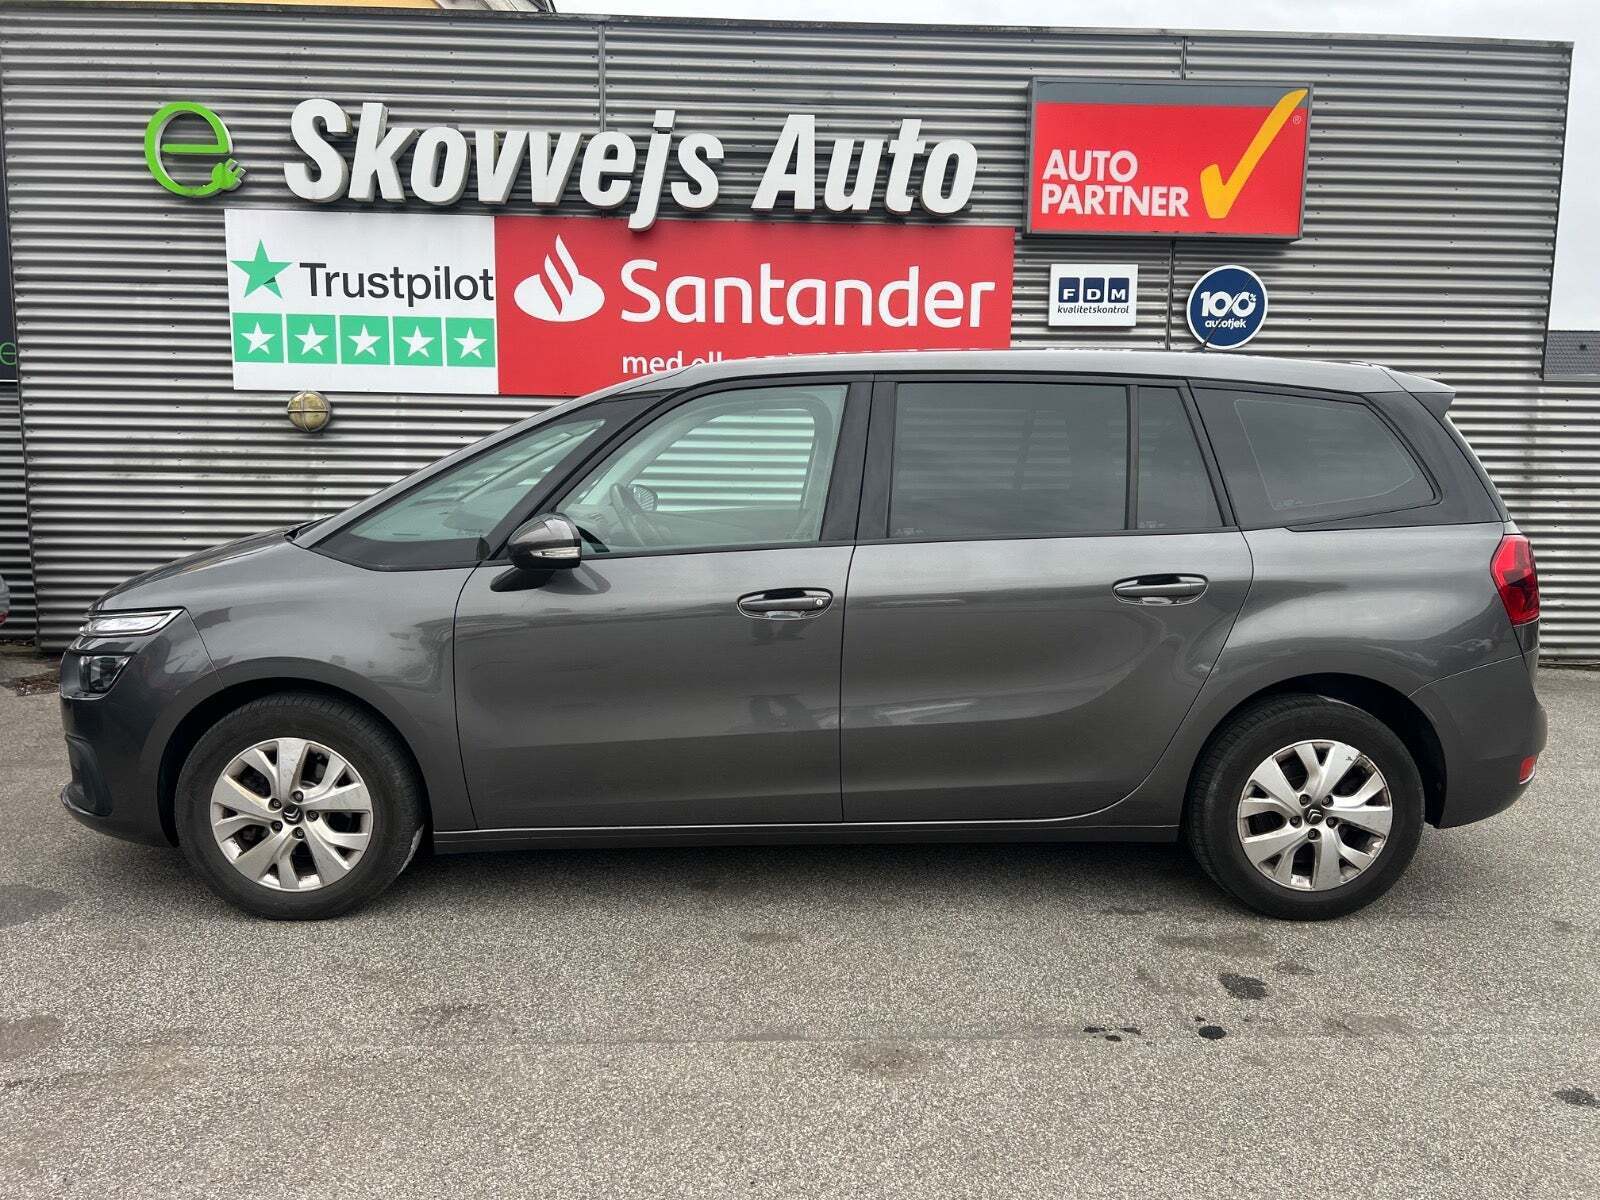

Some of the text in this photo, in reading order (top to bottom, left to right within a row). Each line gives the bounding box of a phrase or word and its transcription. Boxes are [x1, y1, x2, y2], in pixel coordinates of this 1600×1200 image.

[284, 98, 978, 231] Skovvejs Auto
[1042, 148, 1138, 183] AUTO
[1041, 183, 1189, 218] PARTNER
[299, 262, 495, 307] Trustpilot
[620, 258, 996, 328] Santander
[1062, 287, 1127, 301] FDM
[1057, 305, 1129, 314] kvalitetskontrol
[622, 350, 685, 374] med
